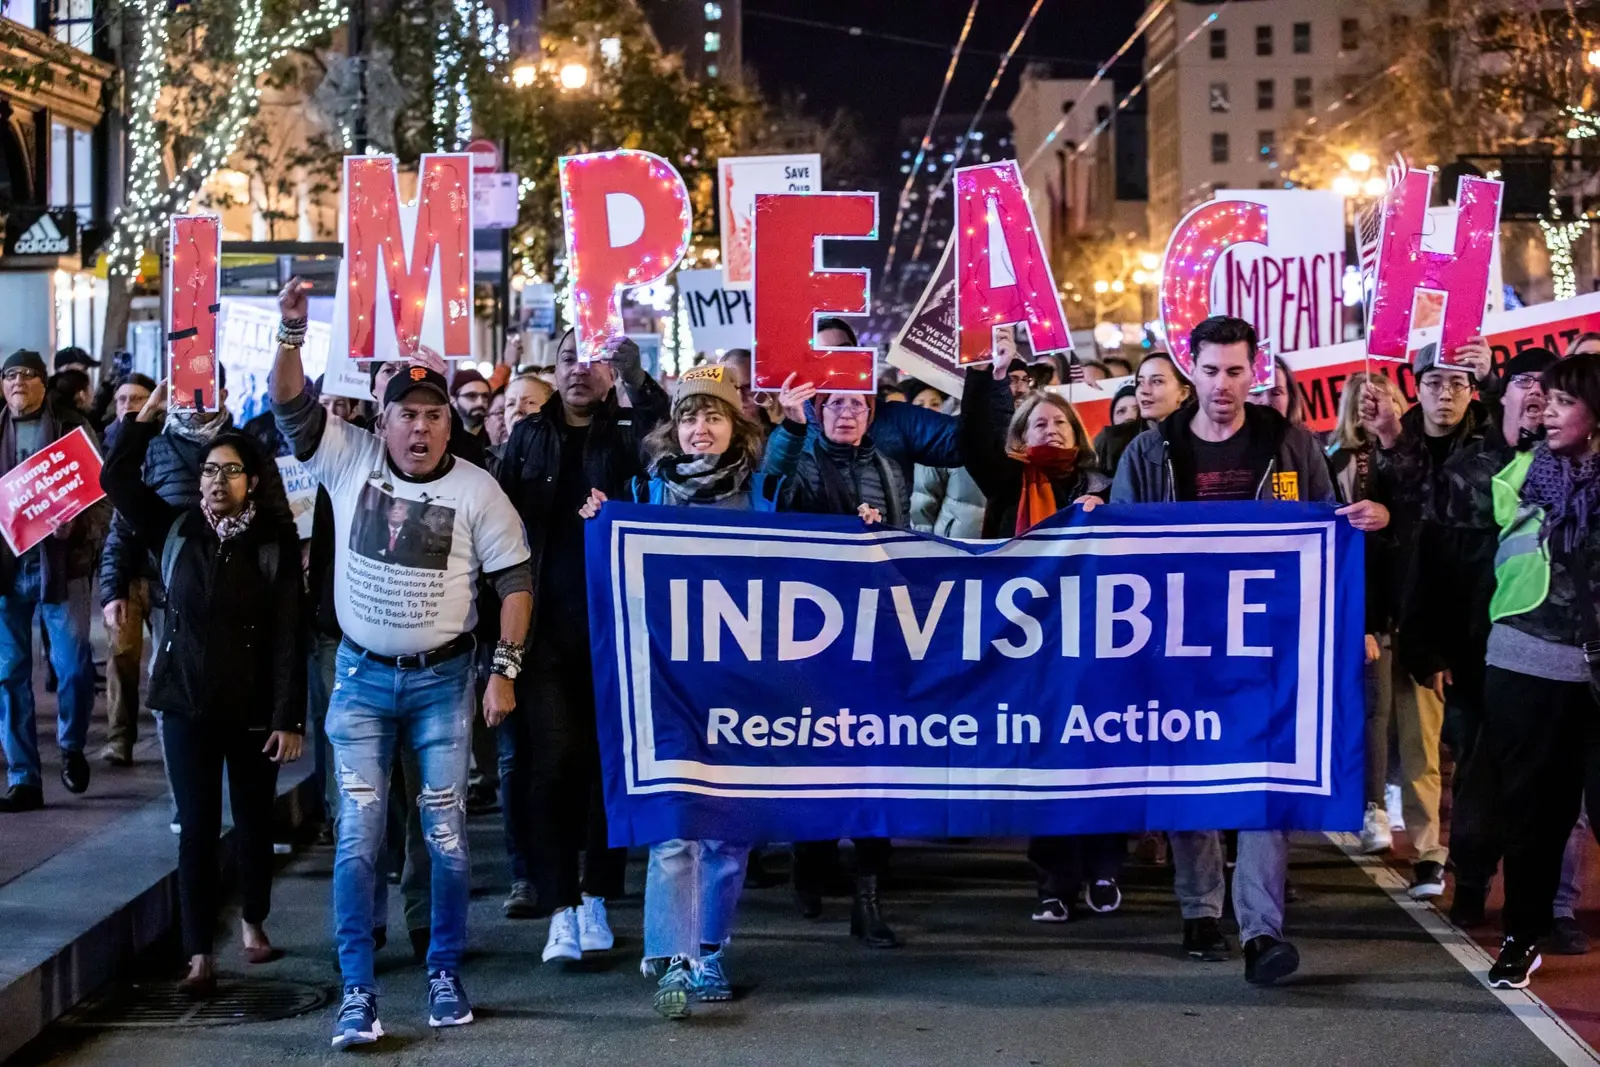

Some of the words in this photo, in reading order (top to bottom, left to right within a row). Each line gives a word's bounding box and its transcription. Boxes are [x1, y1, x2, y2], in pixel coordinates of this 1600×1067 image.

[785, 166, 810, 179] SAVE
[14, 235, 70, 254] adidas
[1225, 250, 1345, 353] IMPEACH
[911, 326, 924, 336] TO
[926, 335, 956, 355] IMPEA
[5, 460, 51, 492] Trump
[48, 450, 66, 464] Is
[8, 488, 35, 512] Not
[34, 460, 80, 494] Above
[22, 498, 51, 521] The
[48, 473, 85, 503] Law!
[360, 557, 382, 570] House
[384, 566, 436, 579] Republicans
[363, 581, 372, 591] Of
[374, 584, 401, 597] Stupid
[403, 588, 428, 598] Idiots
[387, 576, 427, 588] Senators
[429, 580, 444, 588] Are
[373, 604, 383, 615] To
[385, 607, 423, 619] Back-Up
[425, 609, 440, 618] For
[407, 600, 418, 608] To
[421, 600, 438, 608] This
[364, 614, 381, 625] Idiot
[670, 569, 1275, 662] INDIVISIBLE
[707, 707, 979, 747] Resistance
[997, 703, 1041, 744] in
[1060, 700, 1221, 744] Action
